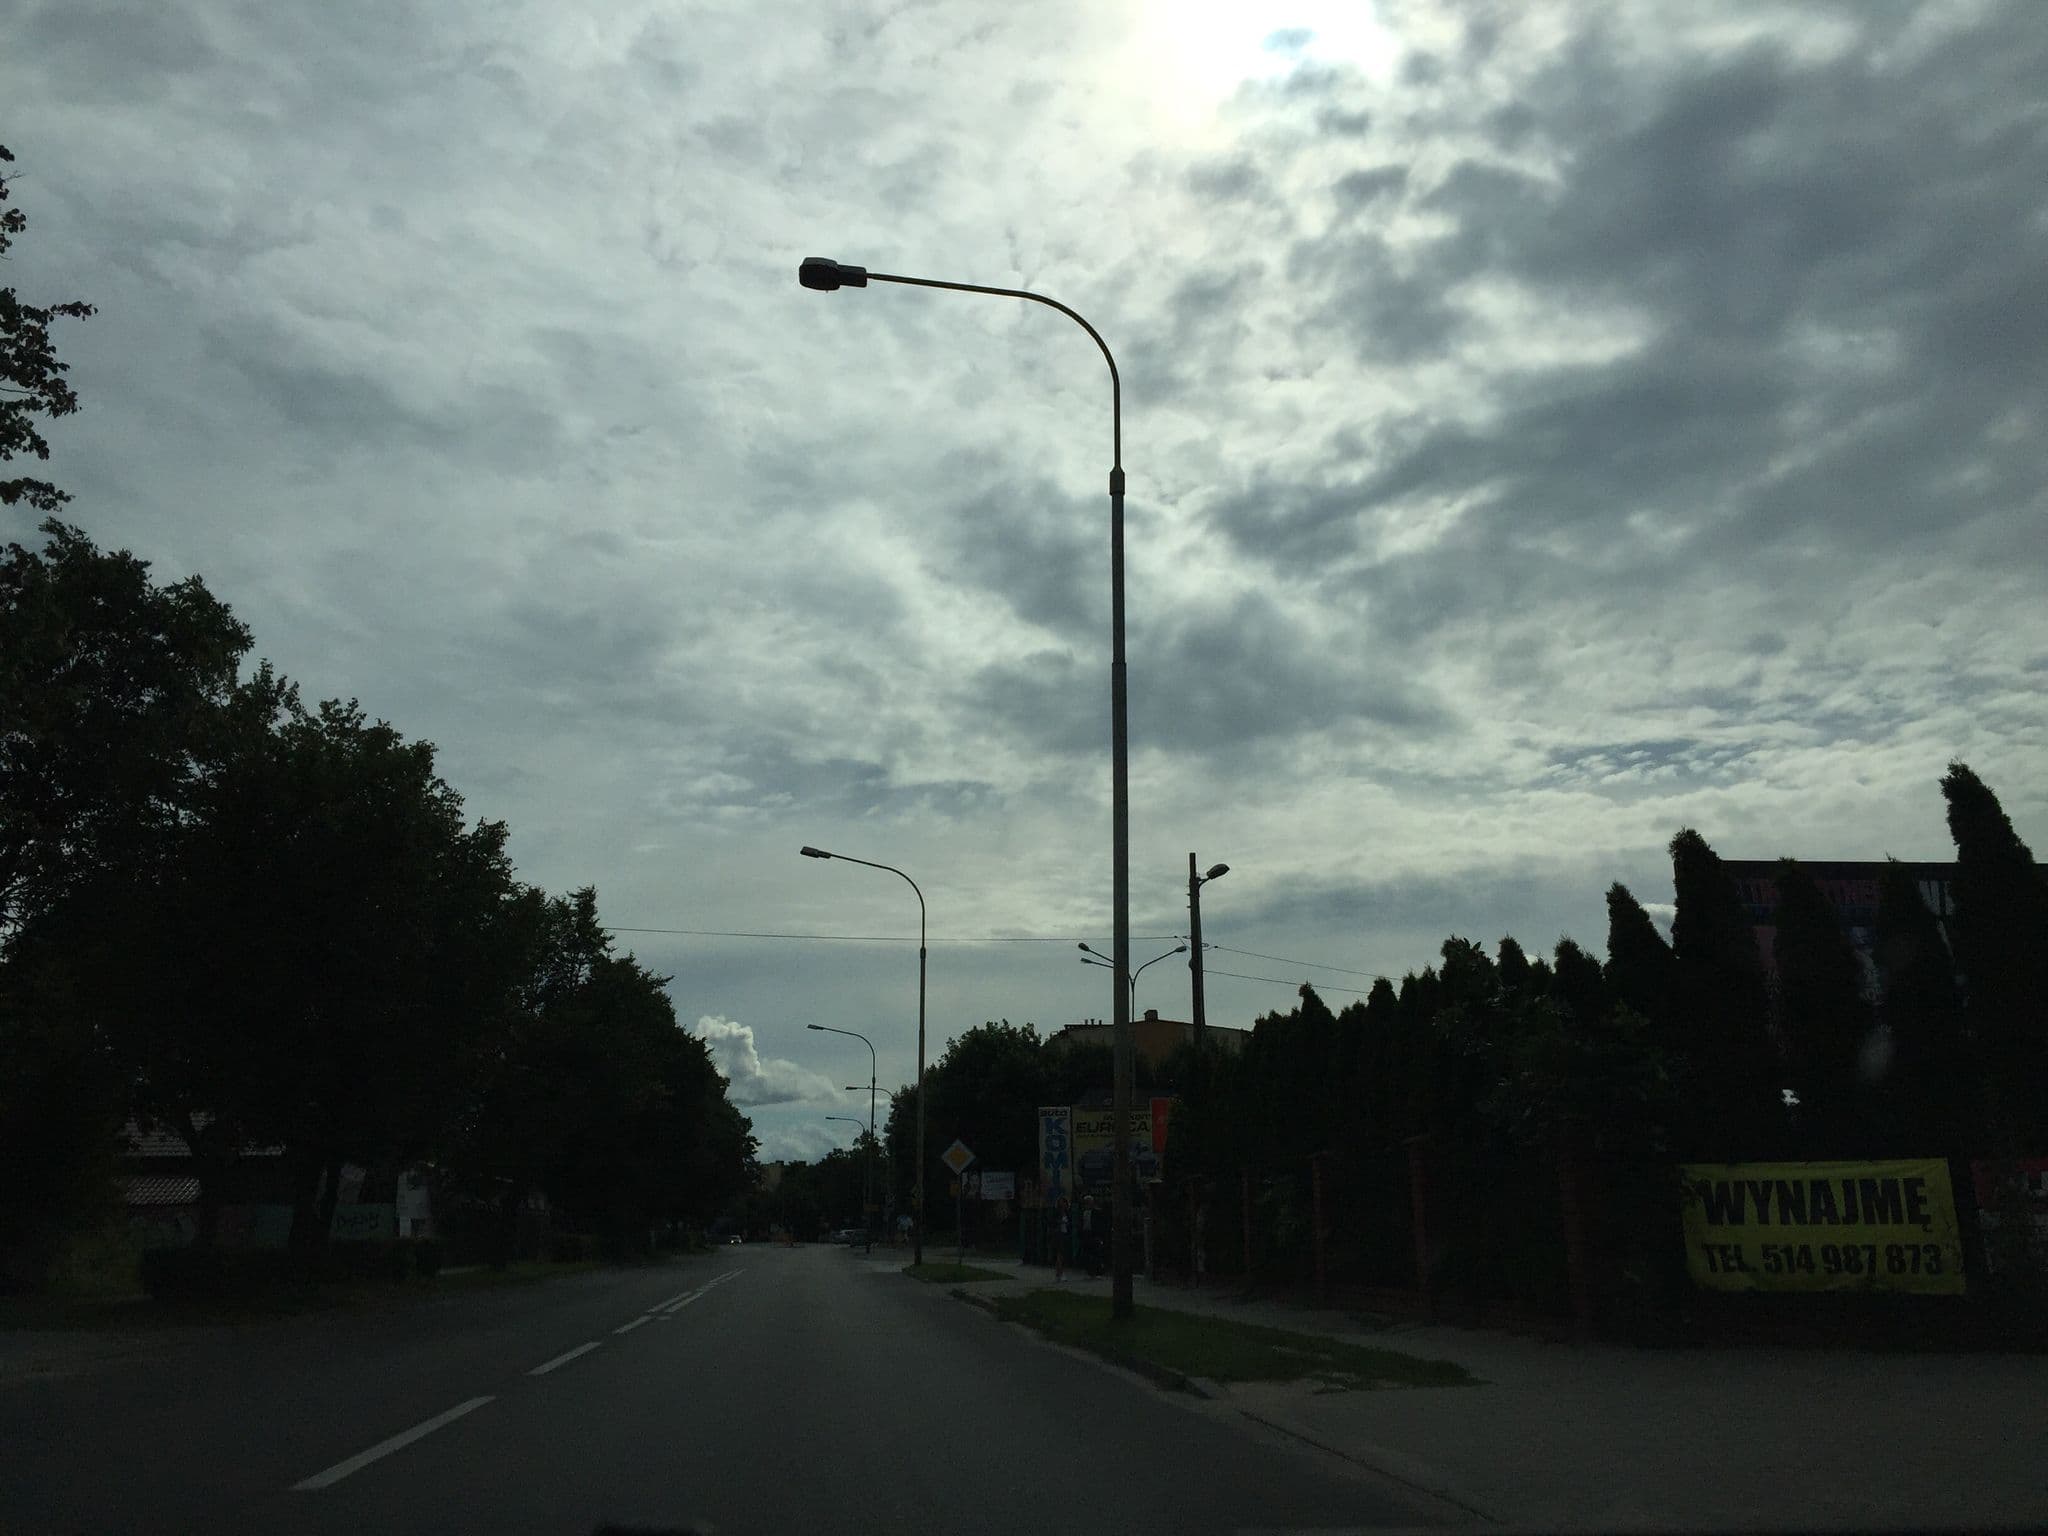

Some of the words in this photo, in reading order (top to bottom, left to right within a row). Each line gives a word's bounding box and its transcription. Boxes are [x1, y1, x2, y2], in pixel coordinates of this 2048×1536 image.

[1697, 1177, 1932, 1233] WYNAJMĘ
[1702, 1244, 1756, 1272] TEL.
[1762, 1244, 1815, 1272] 514
[1821, 1243, 1876, 1274] 987
[1884, 1243, 1941, 1273] 873
